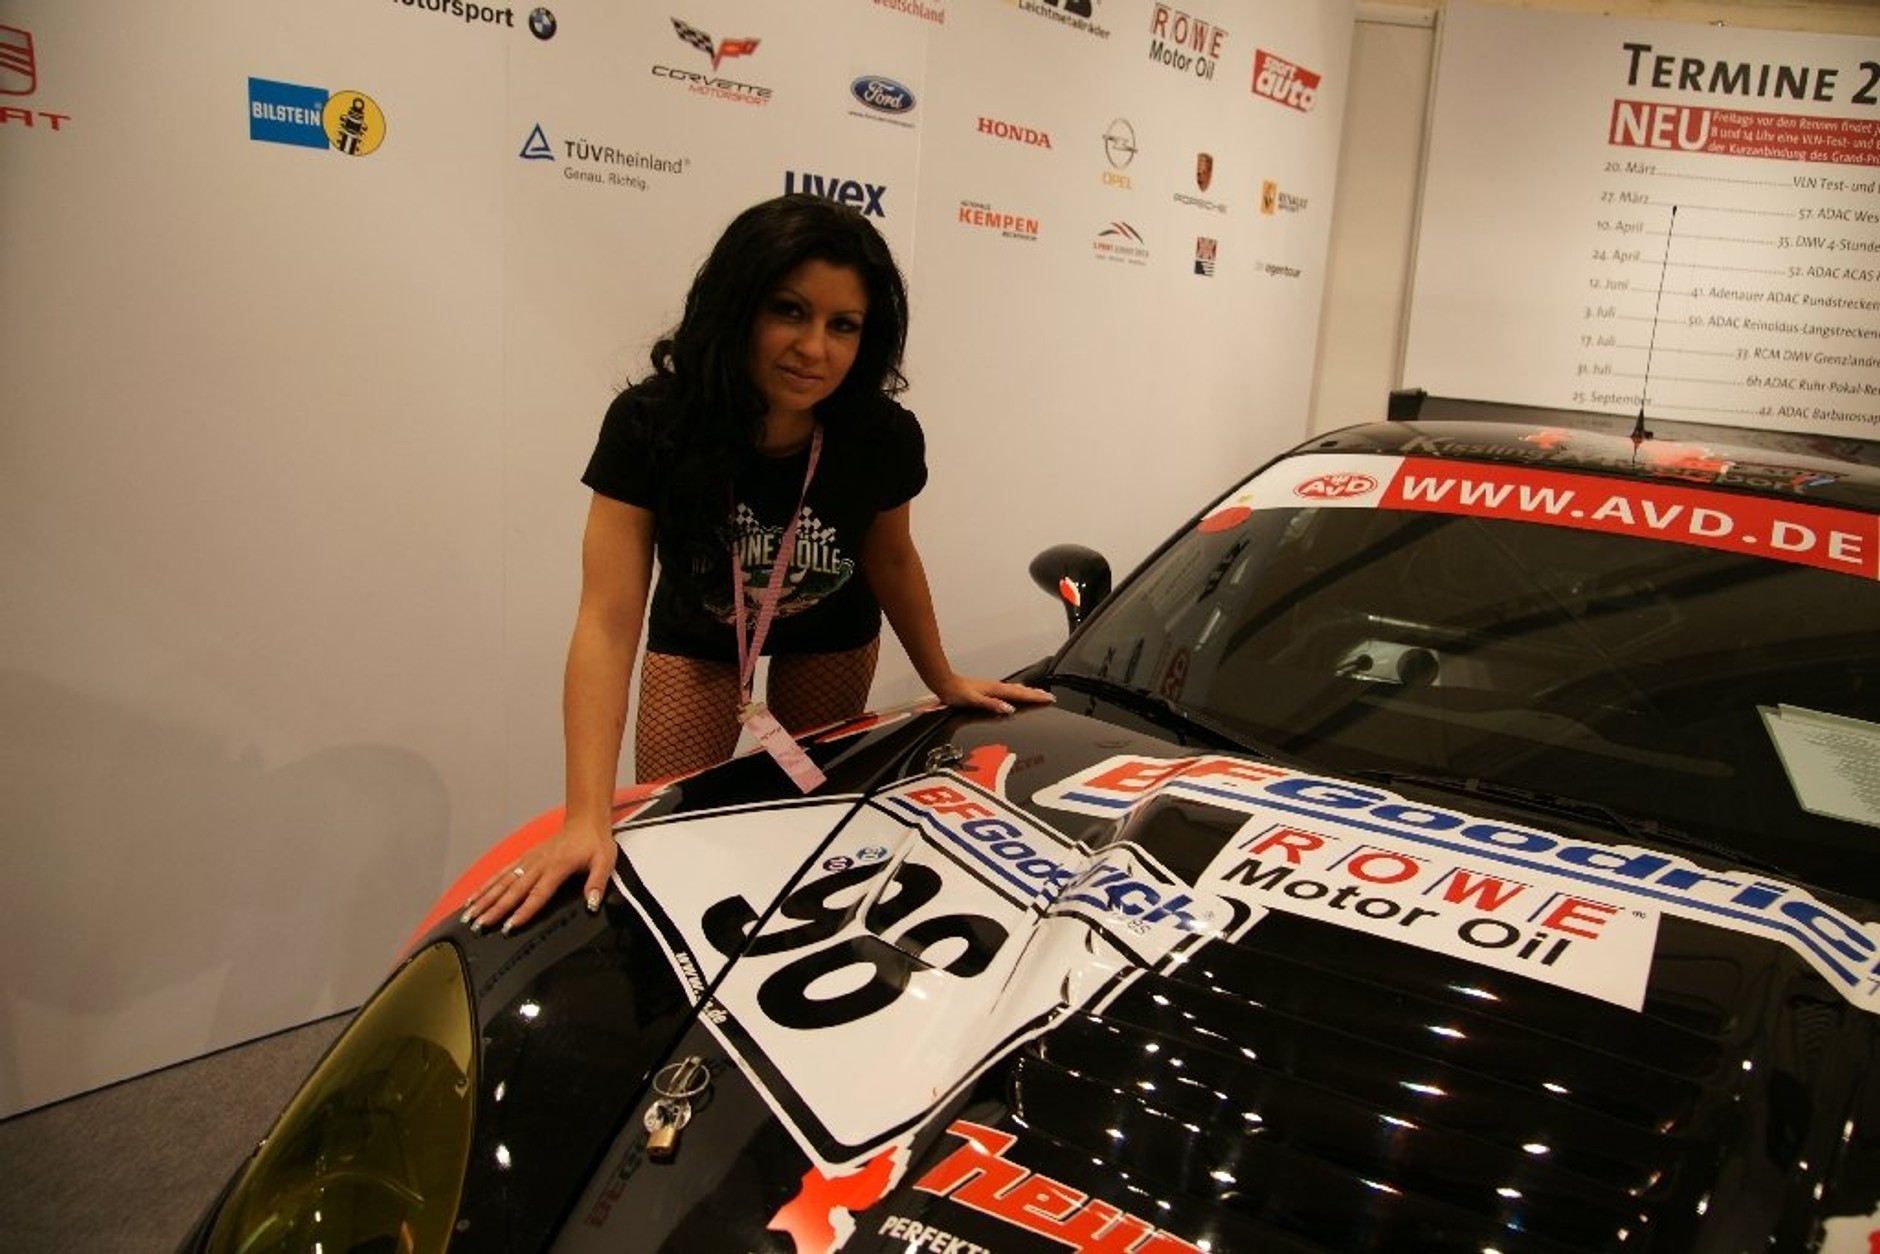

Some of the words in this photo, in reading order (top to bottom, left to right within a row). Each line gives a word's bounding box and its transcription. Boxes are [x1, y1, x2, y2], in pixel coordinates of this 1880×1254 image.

[1152, 7, 1225, 59] ROWE
[1149, 39, 1193, 71] Motor
[1195, 56, 1216, 81] Oil
[864, 81, 906, 109] Ford
[1256, 70, 1317, 112] auto
[252, 101, 321, 126] BILSTEIN
[1613, 103, 1712, 150] NEU
[1712, 110, 1755, 127] Freitags
[1758, 117, 1773, 127] vor
[1776, 116, 1797, 128] den
[1799, 118, 1838, 131] Rennen
[1841, 121, 1873, 134] findet
[977, 117, 1052, 149] HONDA
[1711, 126, 1718, 137] 8
[1720, 127, 1741, 140] und
[1756, 130, 1775, 141] Uhr
[1777, 134, 1799, 145] eine
[1853, 138, 1874, 149] und
[1708, 140, 1726, 153] der
[1729, 143, 1806, 161] Kurzanbindung
[1810, 150, 1828, 161] des
[563, 166, 605, 184] Genau.
[608, 172, 650, 192] Richtig.
[1103, 171, 1132, 190] OPEL
[1625, 162, 1656, 175] März
[1793, 176, 1817, 188] VLN
[1820, 178, 1849, 191] Test-
[1851, 180, 1876, 194] und
[785, 170, 887, 218] uvex
[1619, 191, 1649, 204] März
[1818, 208, 1852, 221] ADAC
[958, 207, 1039, 234] KEMPEN
[1615, 221, 1643, 235] April
[1795, 235, 1827, 249] DMV
[1612, 250, 1640, 262] April
[1807, 266, 1841, 279] ADAC
[1842, 268, 1876, 281] ACAS
[1604, 279, 1629, 290] Juni
[1708, 286, 1765, 302] Adenauer
[1767, 291, 1800, 304] ADAC
[1597, 306, 1616, 319] Juli
[1708, 315, 1740, 329] ADAC
[1596, 335, 1616, 347] Juli
[1753, 347, 1781, 361] RCM
[1783, 350, 1813, 362] DMV
[1593, 363, 1613, 376] Juli
[1746, 376, 1763, 389] 6h
[1764, 378, 1799, 391] ADAC
[1778, 405, 1810, 418] ADAC
[1401, 476, 1864, 564] WWW.AVD.DE
[1082, 758, 1880, 976] BFGoodric
[1248, 828, 1620, 940] ROWE
[1220, 857, 1440, 928] Motor
[1456, 917, 1573, 967] Oil
[701, 860, 1010, 1030] 96
